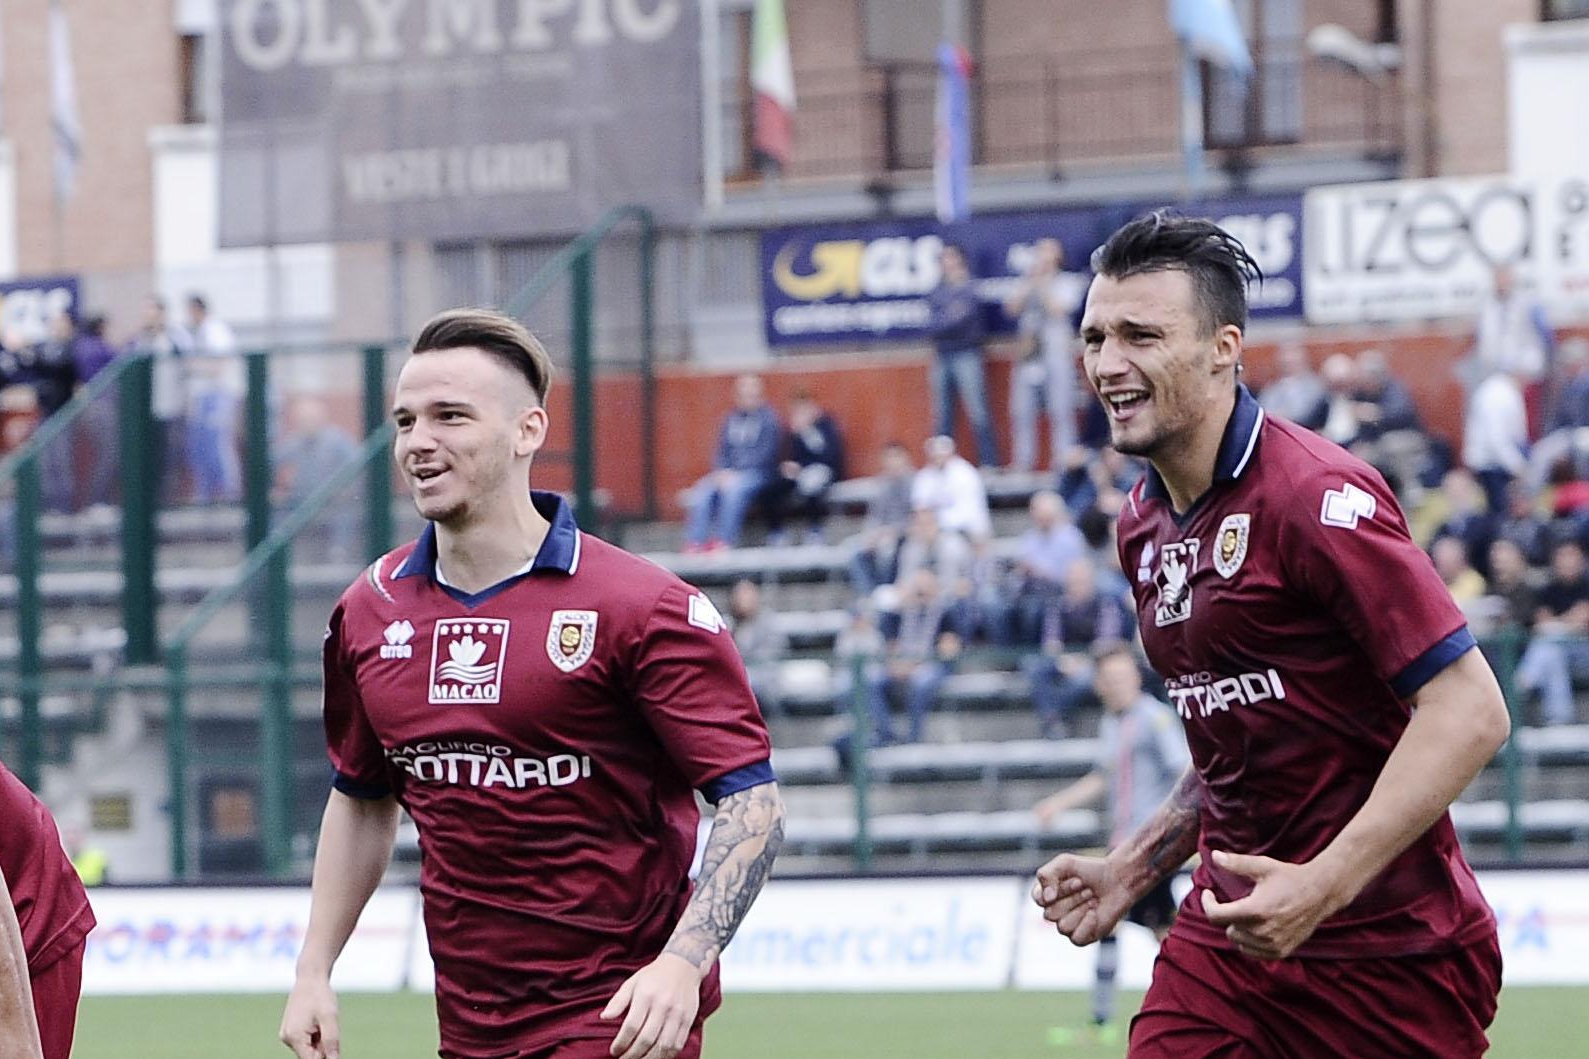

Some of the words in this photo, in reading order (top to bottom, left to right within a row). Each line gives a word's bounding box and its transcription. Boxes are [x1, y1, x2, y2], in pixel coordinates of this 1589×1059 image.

[232, 0, 680, 71] OLYMPIC
[433, 683, 498, 700] MACAO
[1168, 668, 1286, 720] TTARDI
[96, 917, 300, 964] ORAMA
